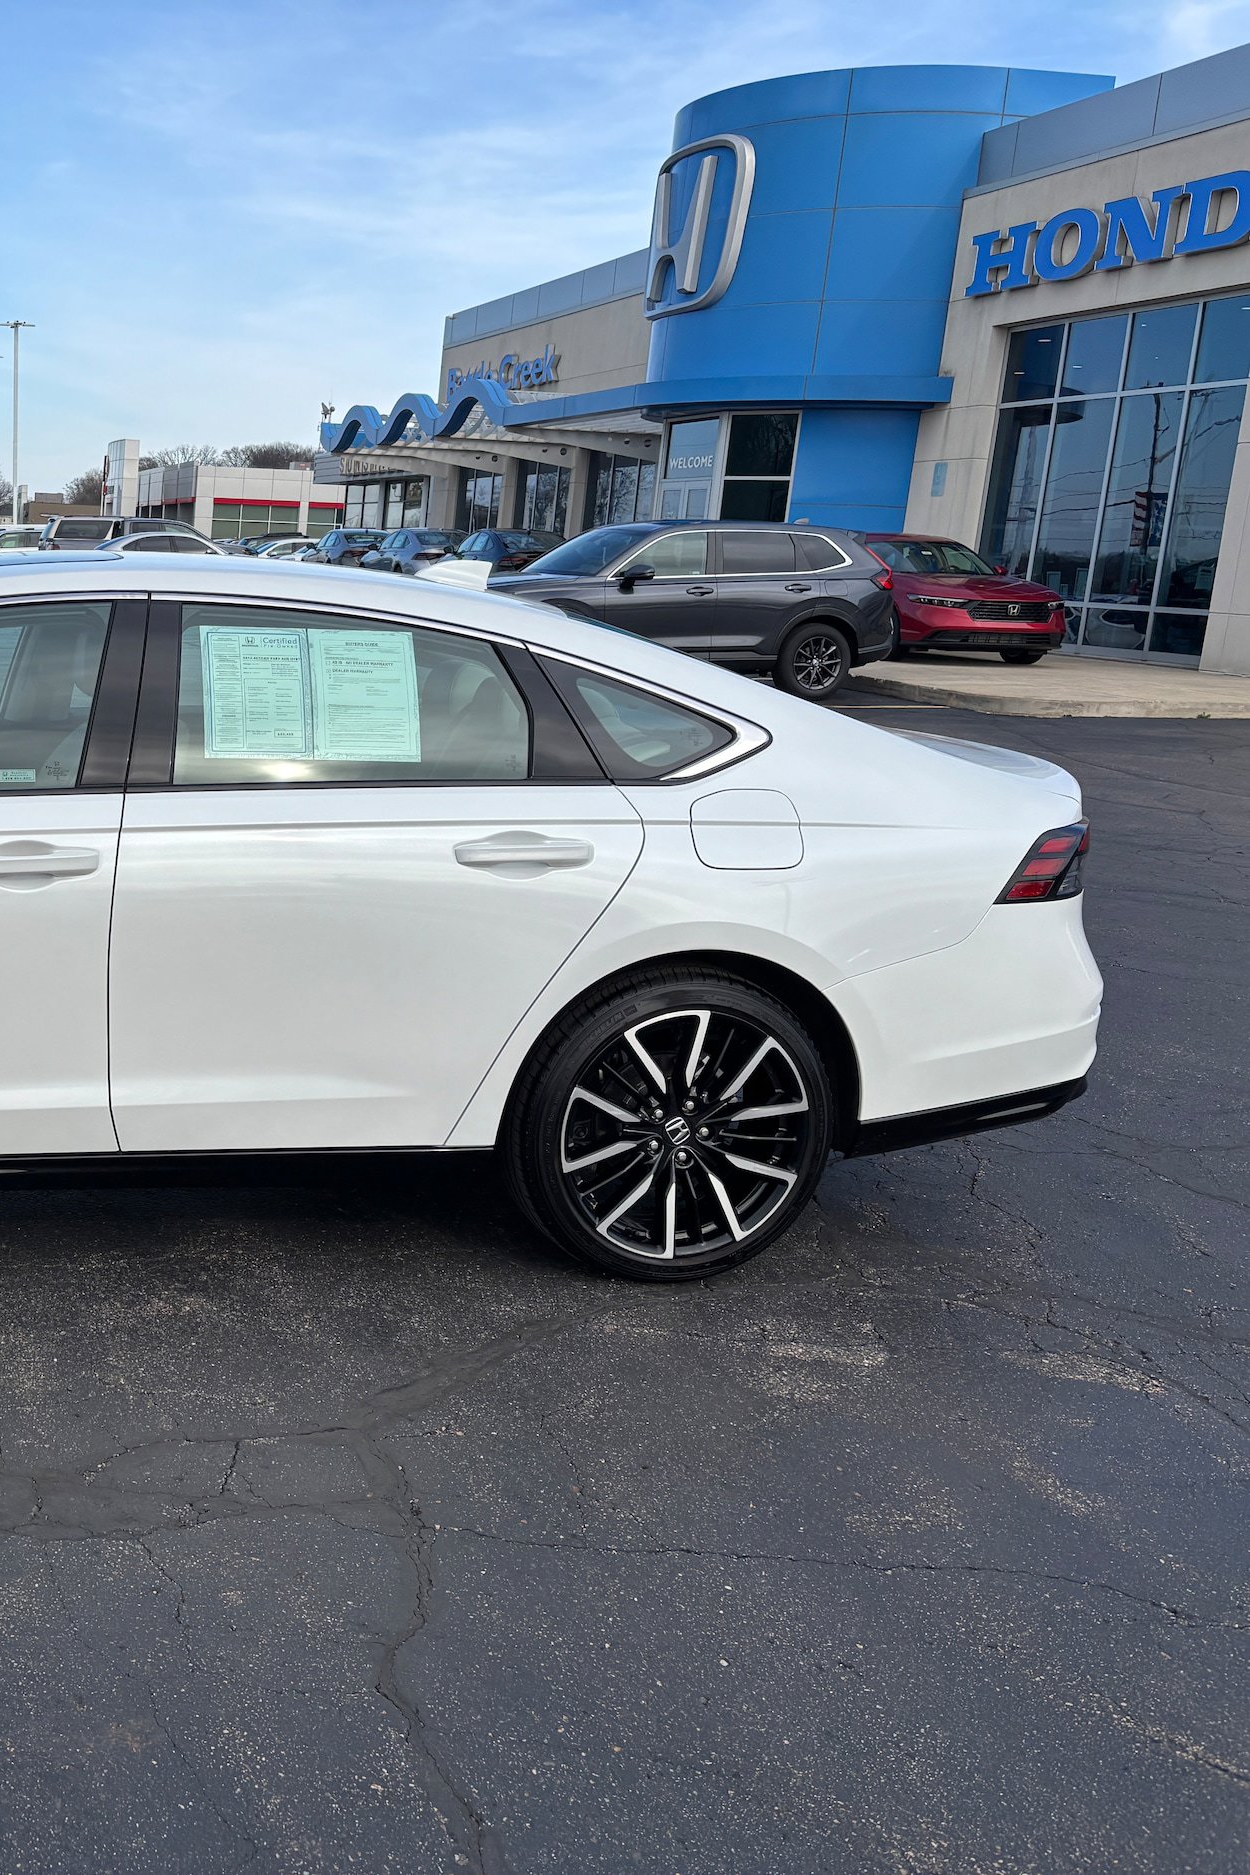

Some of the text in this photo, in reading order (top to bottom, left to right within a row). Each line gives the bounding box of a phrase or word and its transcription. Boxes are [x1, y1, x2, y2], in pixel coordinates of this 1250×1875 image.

[499, 344, 561, 391] Creek
[670, 455, 713, 469] WELCOME
[262, 637, 298, 645] Certified
